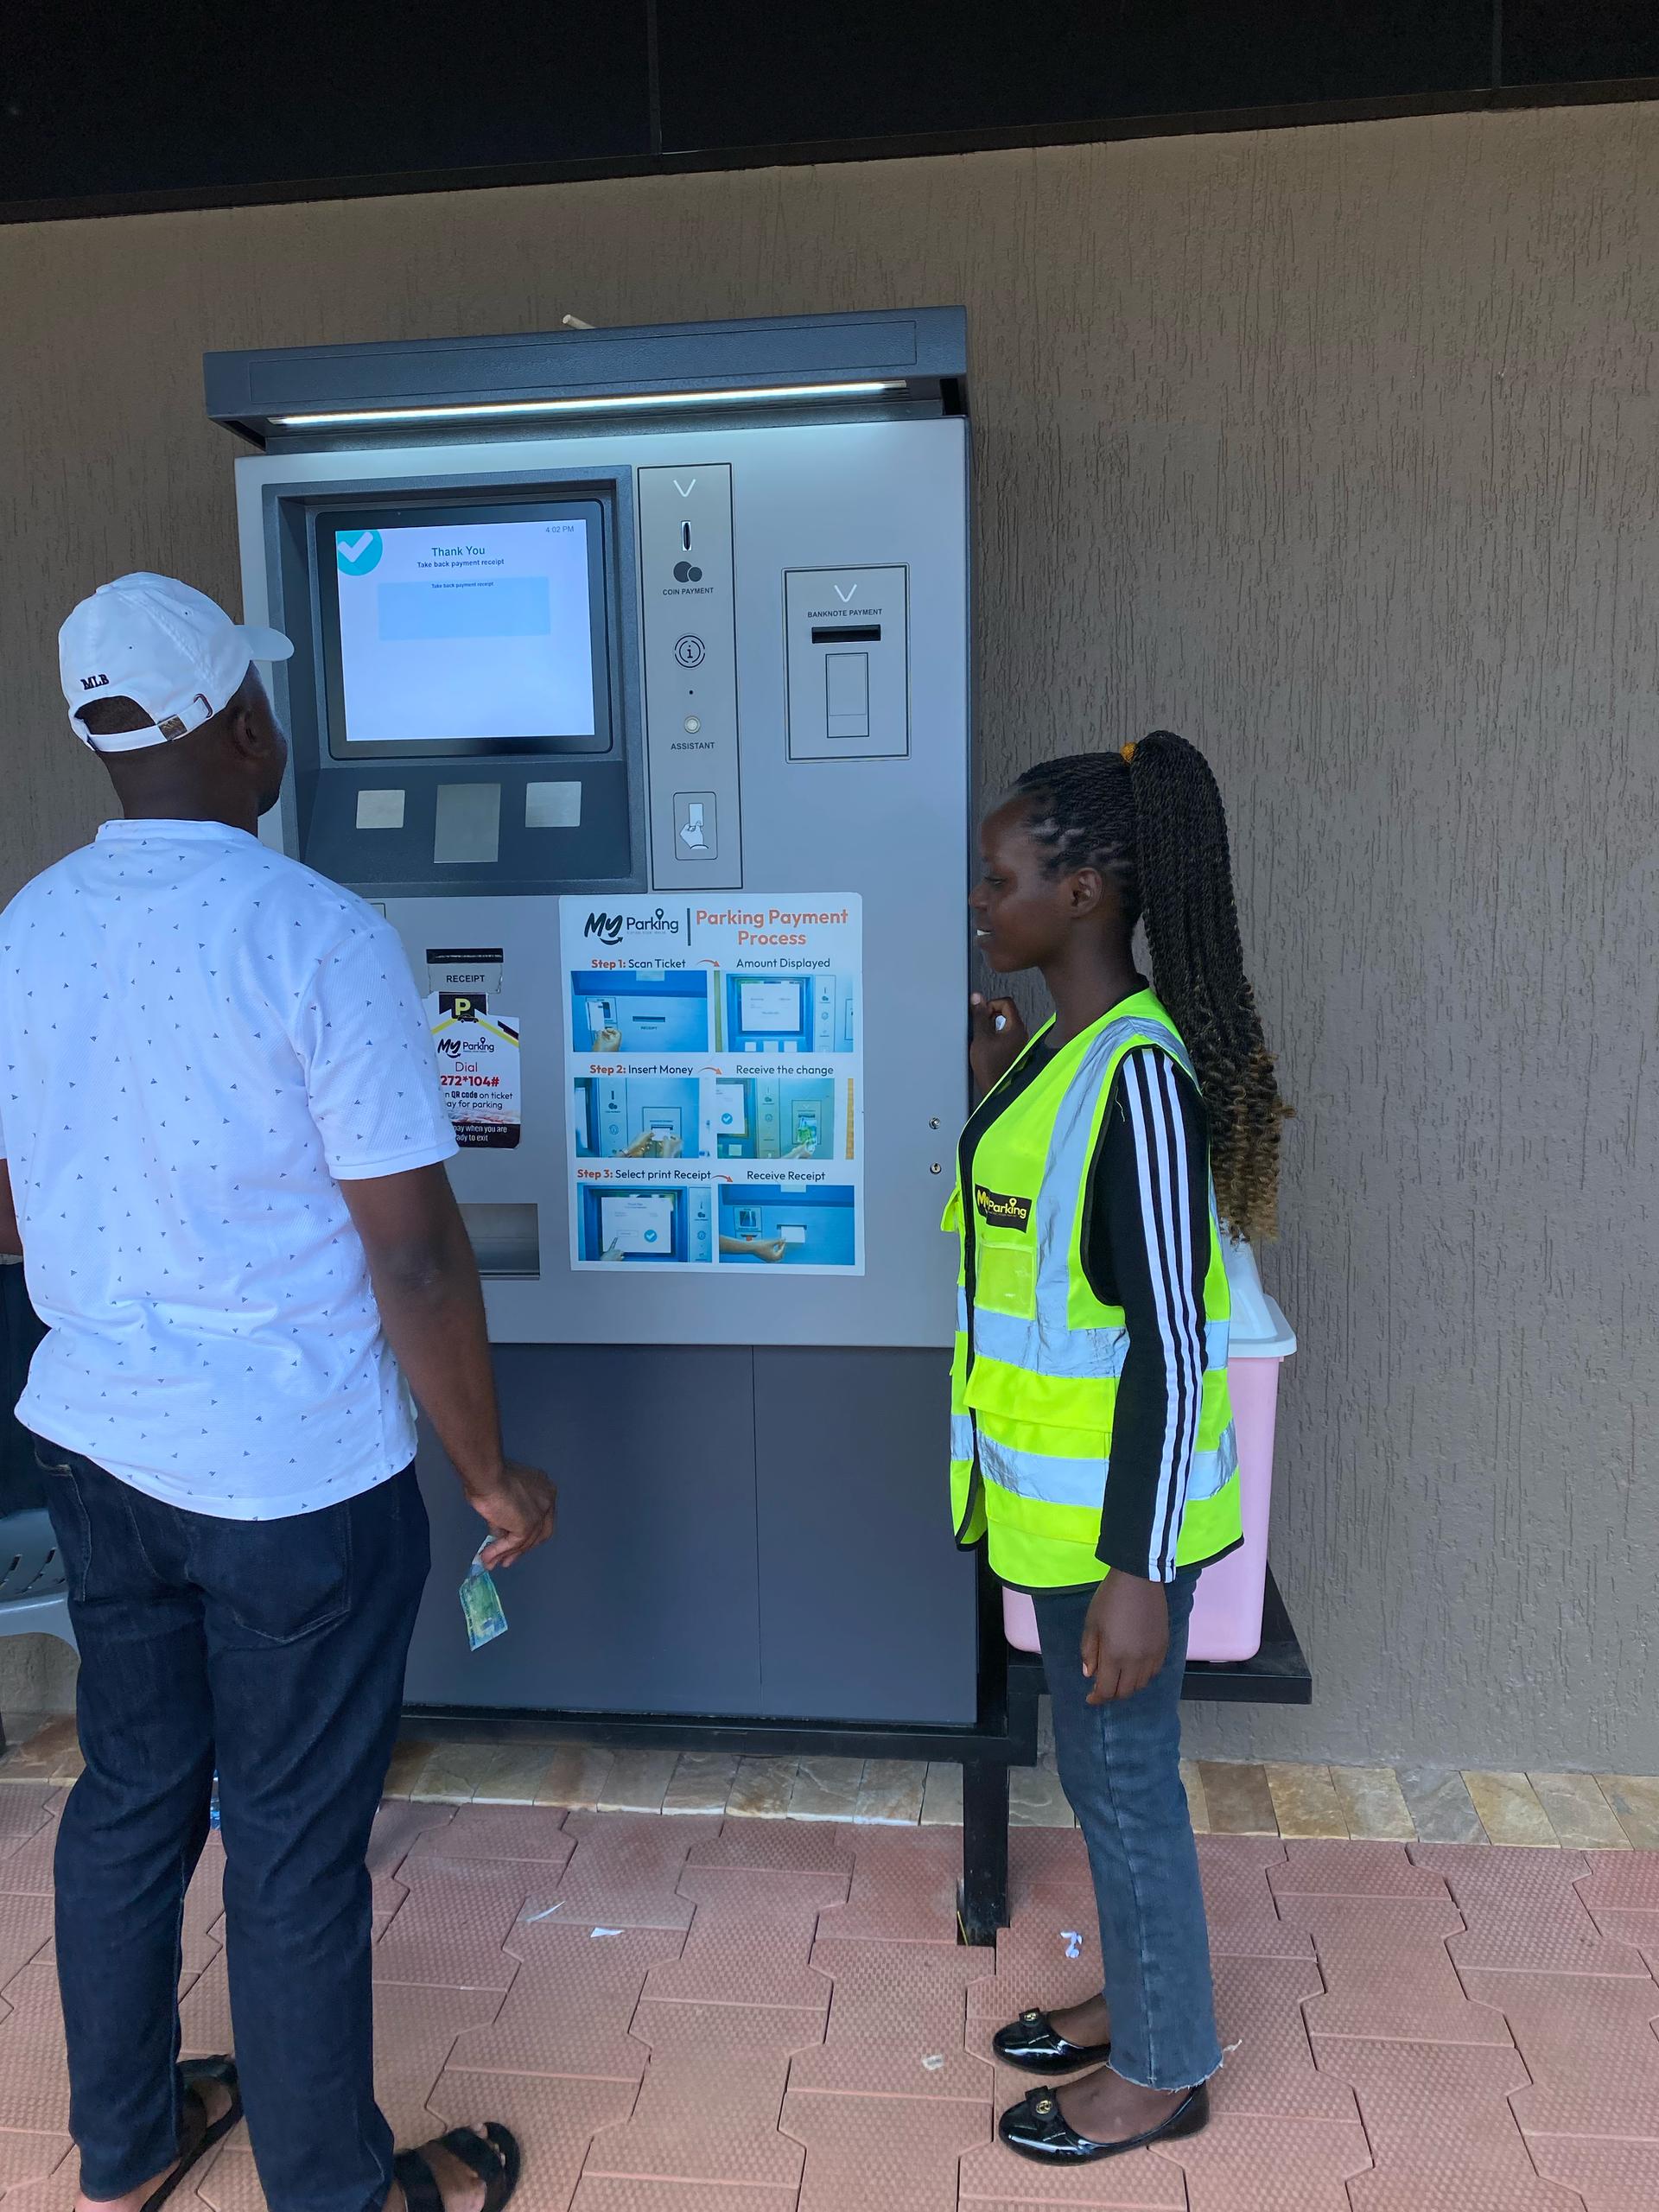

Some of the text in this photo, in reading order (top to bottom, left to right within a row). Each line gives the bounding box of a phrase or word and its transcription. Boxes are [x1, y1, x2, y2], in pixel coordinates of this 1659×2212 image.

[563, 524, 575, 533] PM
[431, 545, 486, 557] Thank You
[451, 559, 480, 569] payment
[481, 558, 505, 568] receipt
[807, 608, 882, 619] BANKNOTE PAYMENT
[80, 674, 110, 690] MLB
[584, 908, 679, 938] My Parking
[696, 908, 849, 929] Parking Payment
[738, 931, 807, 946] Process
[591, 958, 686, 971] Step 1: Scan Ticket
[736, 957, 830, 970] Amount Displayed
[454, 997, 471, 1016] P
[437, 1037, 494, 1054] My Parking
[455, 1062, 478, 1072] Dial
[589, 1065, 693, 1077] Step 2: Insert Money
[736, 1065, 834, 1077] Receive the change
[451, 1090, 461, 1099] QR
[461, 1090, 478, 1099] code
[491, 1091, 513, 1100] ticket
[473, 1101, 503, 1110] parking
[484, 1125, 496, 1134] you
[577, 1169, 711, 1182] Step 3: Select print Receipt
[747, 1171, 825, 1182] Receive Receipt
[988, 1198, 1027, 1219] Parking
